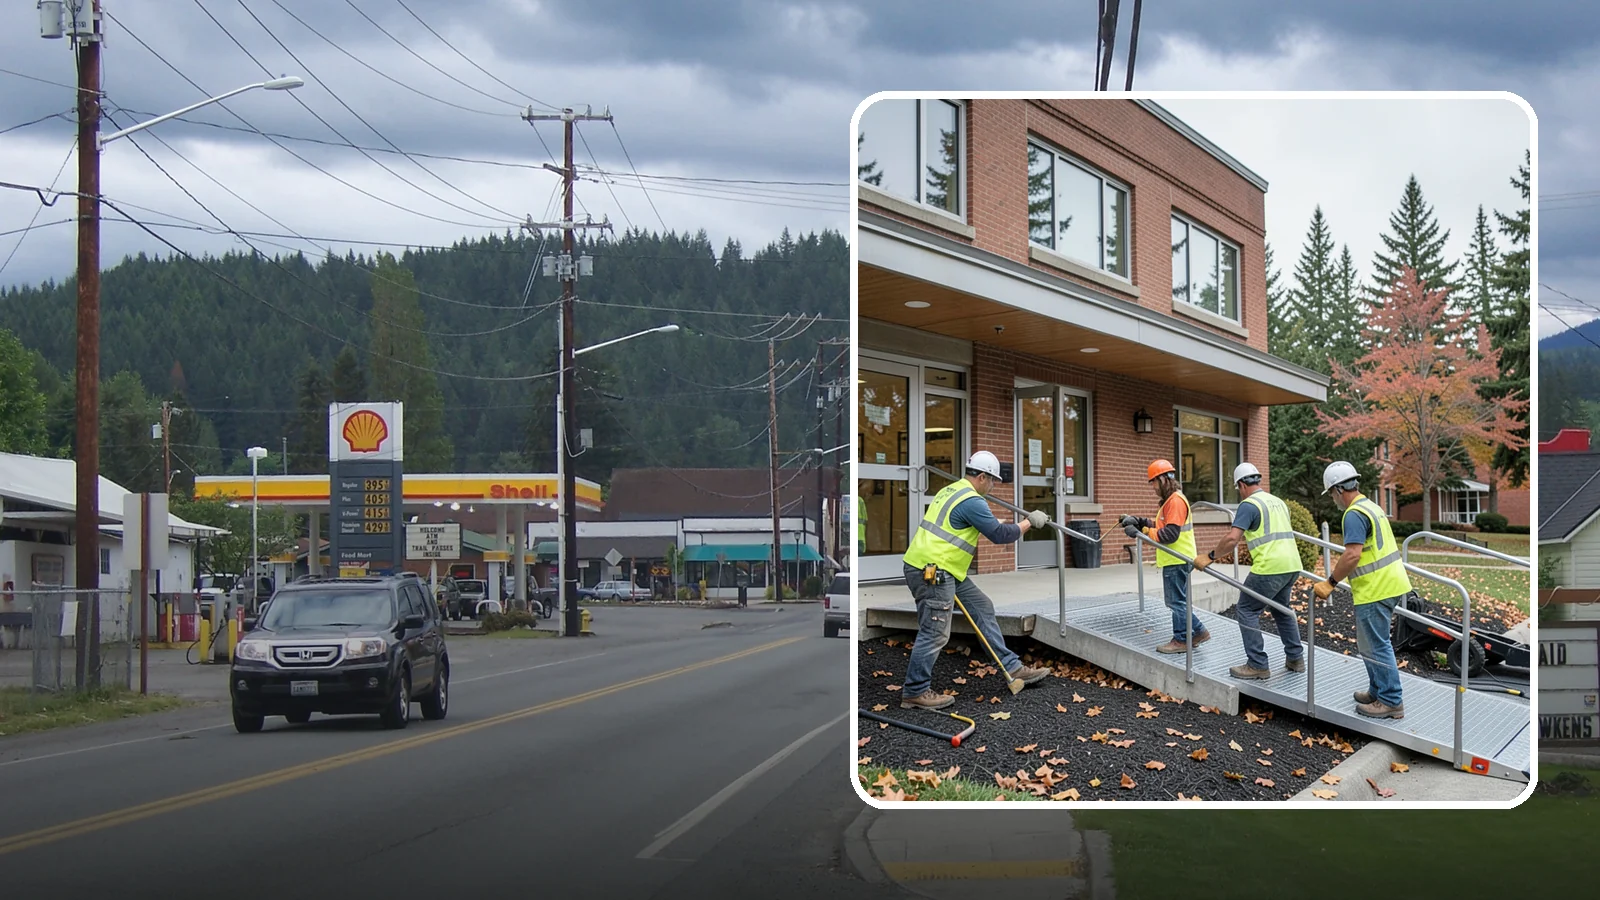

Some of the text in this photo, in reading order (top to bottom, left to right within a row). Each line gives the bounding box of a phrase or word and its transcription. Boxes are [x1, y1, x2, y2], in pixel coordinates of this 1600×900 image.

[366, 480, 383, 490] 395
[490, 485, 547, 499] Shell
[366, 494, 383, 504] 405
[366, 508, 383, 518] 415
[366, 522, 383, 532] 429
[1539, 643, 1566, 665] AID
